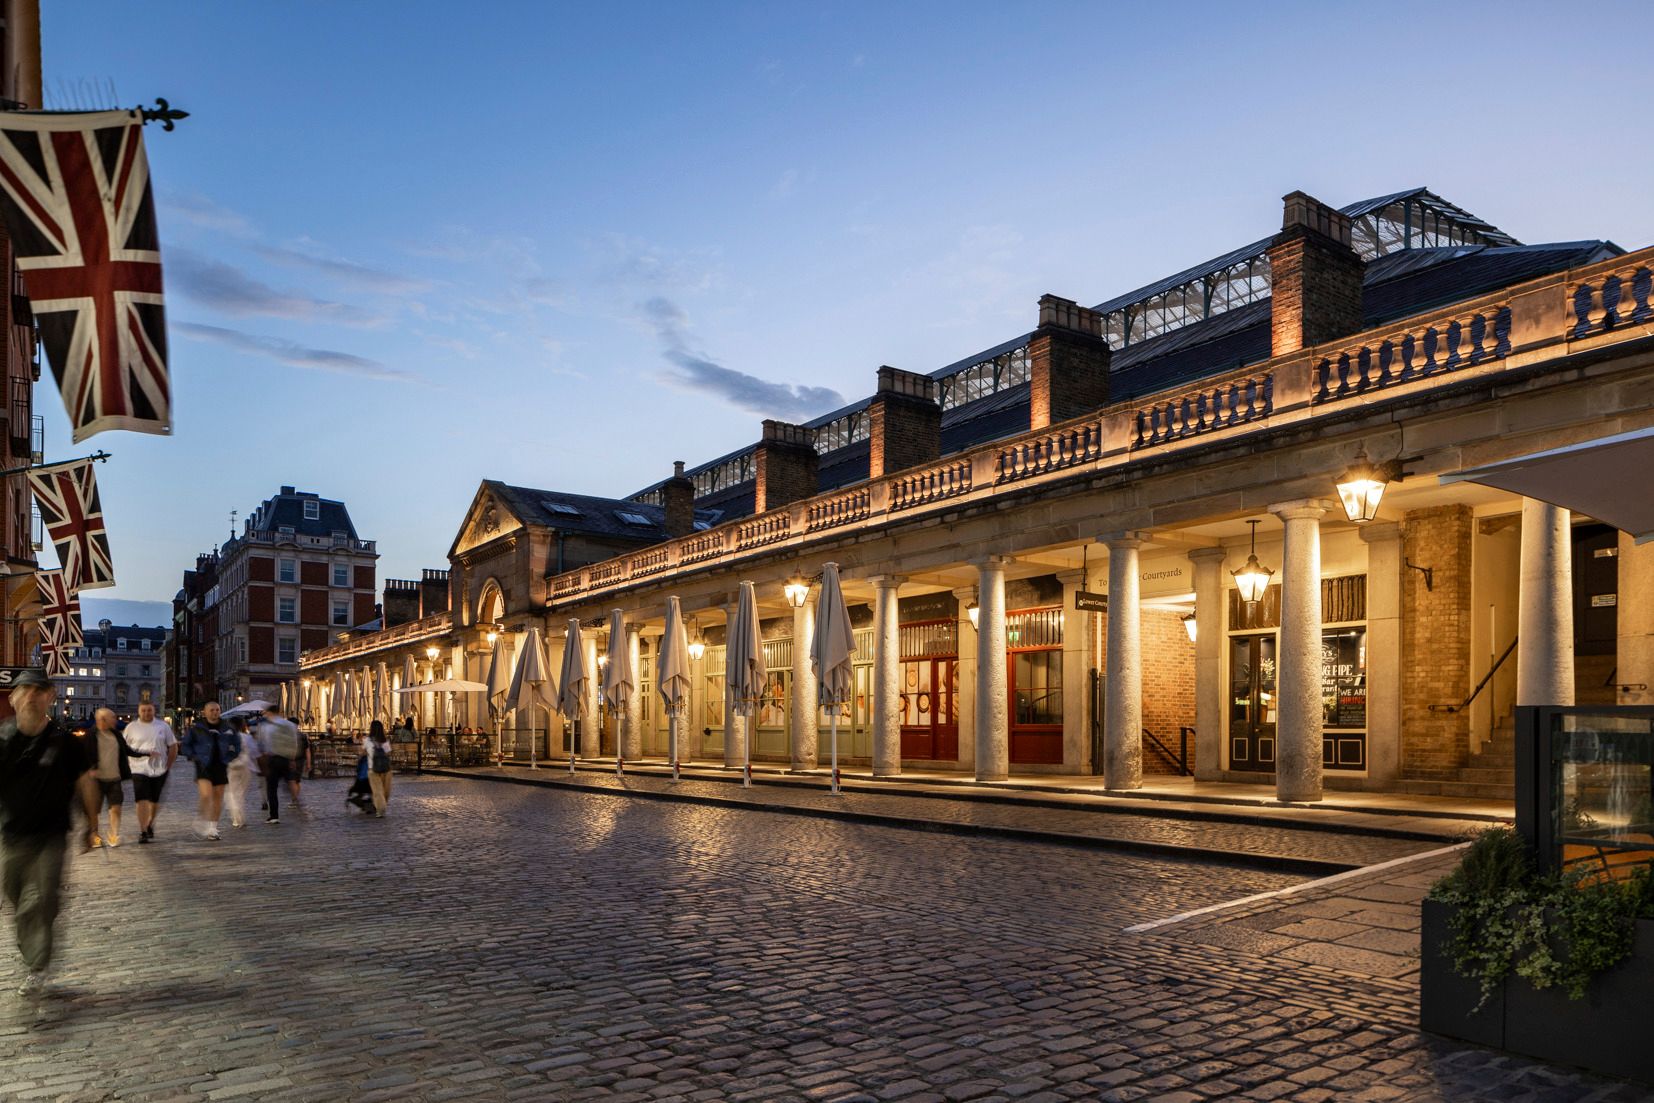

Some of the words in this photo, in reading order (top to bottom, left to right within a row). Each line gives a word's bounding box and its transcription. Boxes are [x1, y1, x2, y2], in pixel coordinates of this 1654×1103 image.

[1098, 579, 1107, 587] To
[1142, 567, 1182, 580] Courtyards
[1332, 665, 1353, 676] PIPE
[1340, 688, 1352, 696] WE
